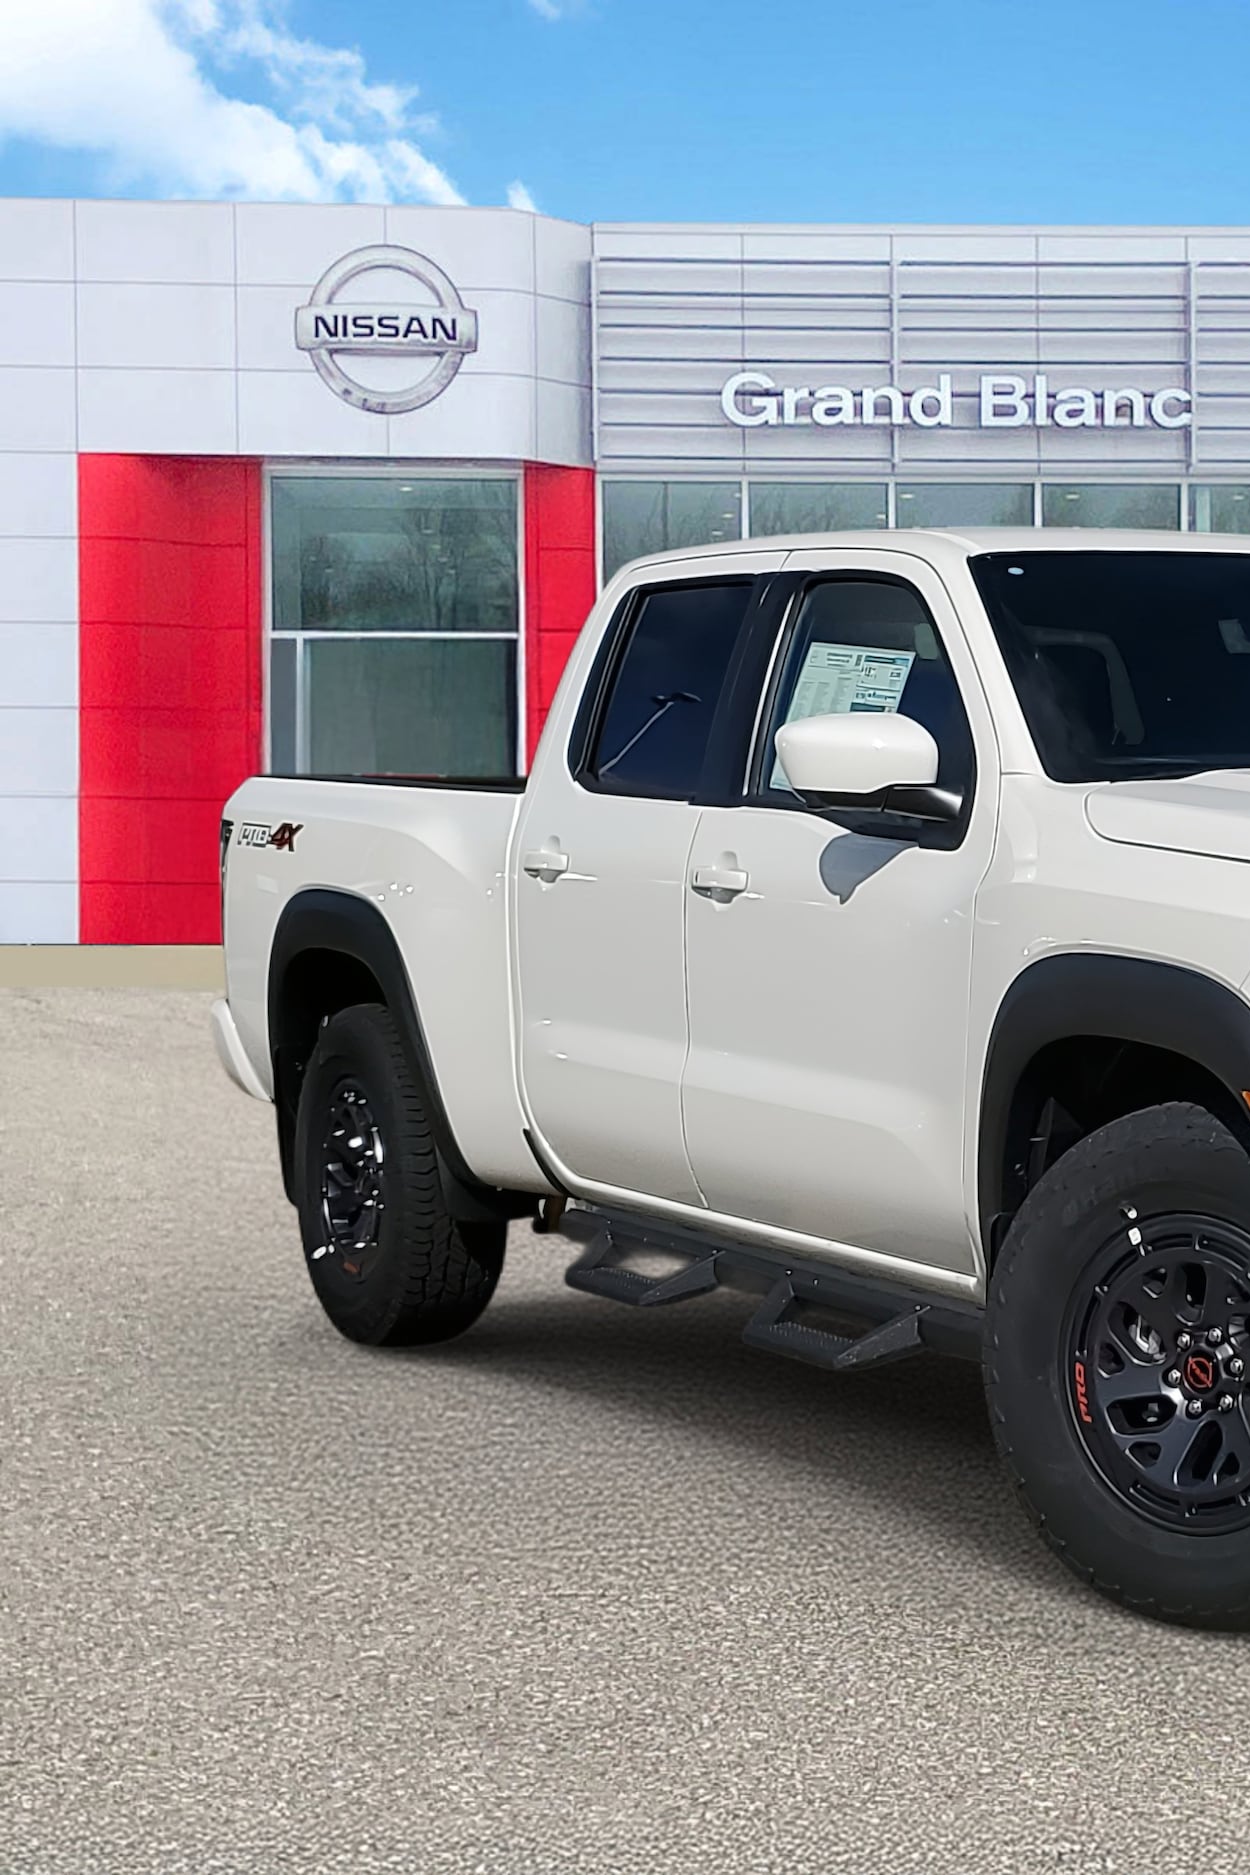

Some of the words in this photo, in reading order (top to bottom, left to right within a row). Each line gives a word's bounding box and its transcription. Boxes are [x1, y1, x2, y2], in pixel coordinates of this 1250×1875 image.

[314, 314, 457, 341] NISSAN
[721, 372, 952, 427] Grand
[980, 374, 1193, 428] Blanc
